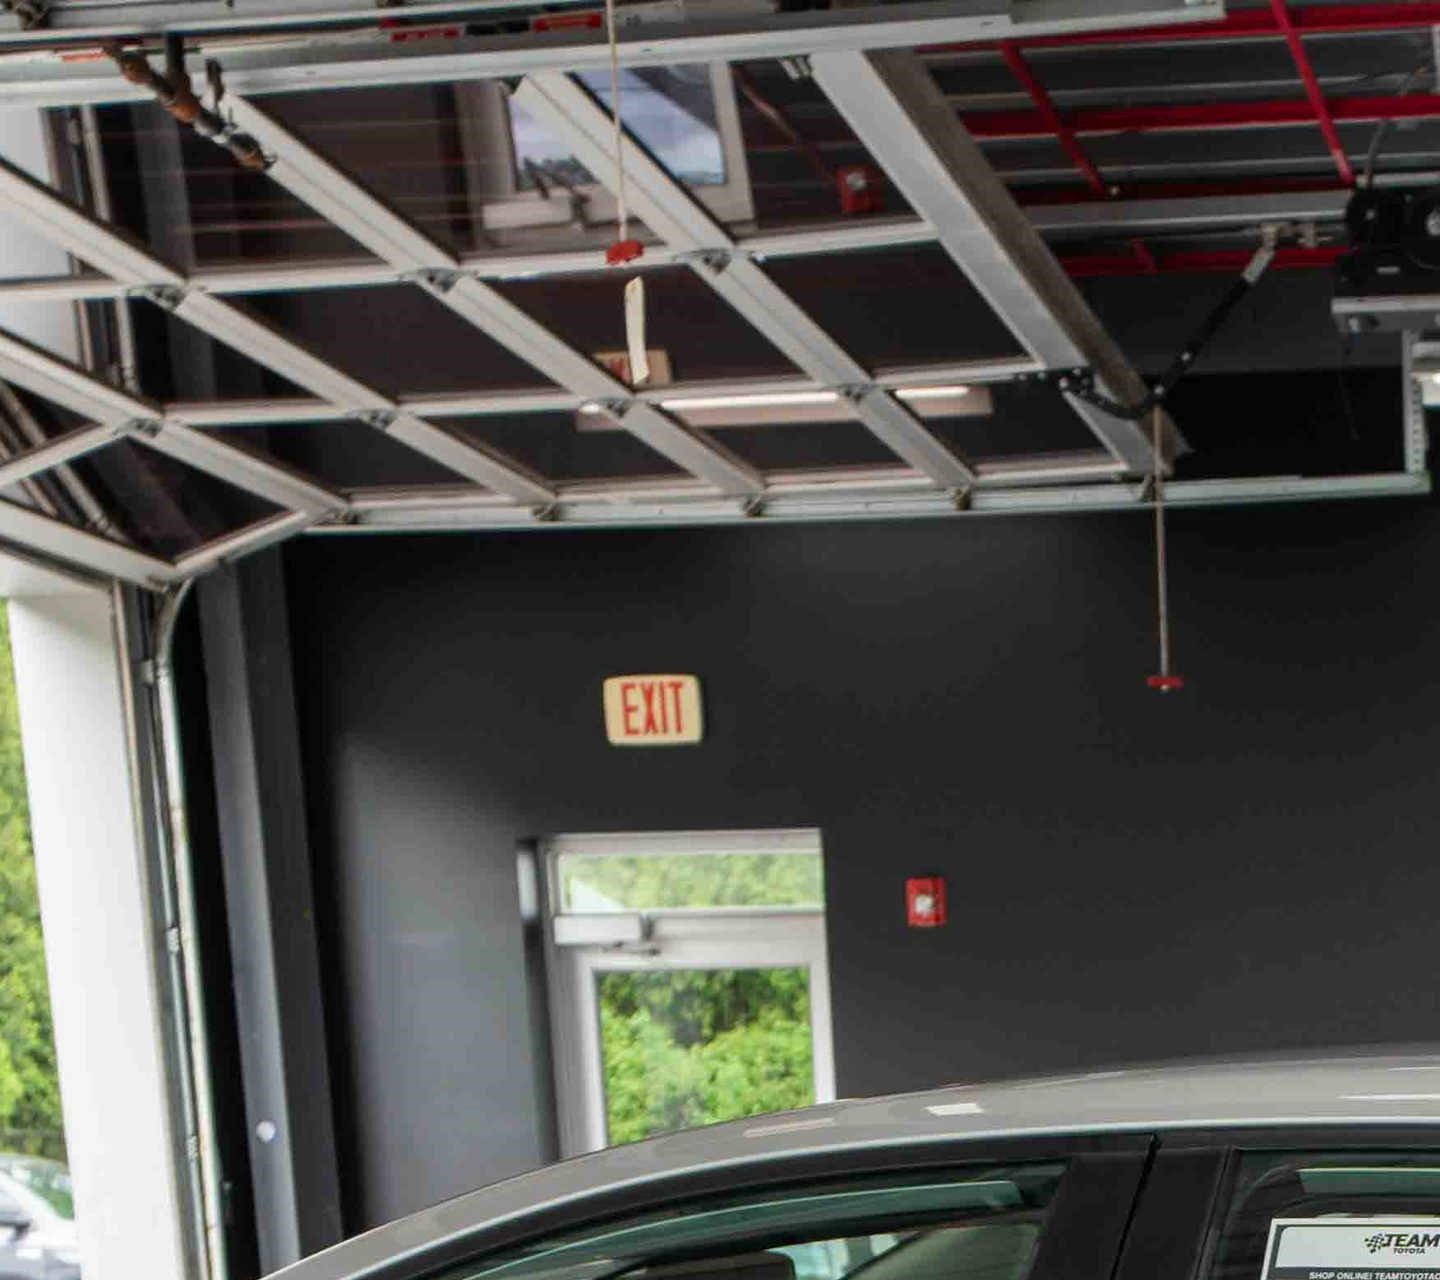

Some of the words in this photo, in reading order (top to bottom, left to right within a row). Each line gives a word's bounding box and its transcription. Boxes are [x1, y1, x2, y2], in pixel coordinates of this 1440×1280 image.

[621, 681, 683, 736] EXIT
[1384, 1234, 1440, 1247] TEAM
[1309, 1271, 1335, 1280] SHOP
[1336, 1271, 1373, 1280] ONLINE!
